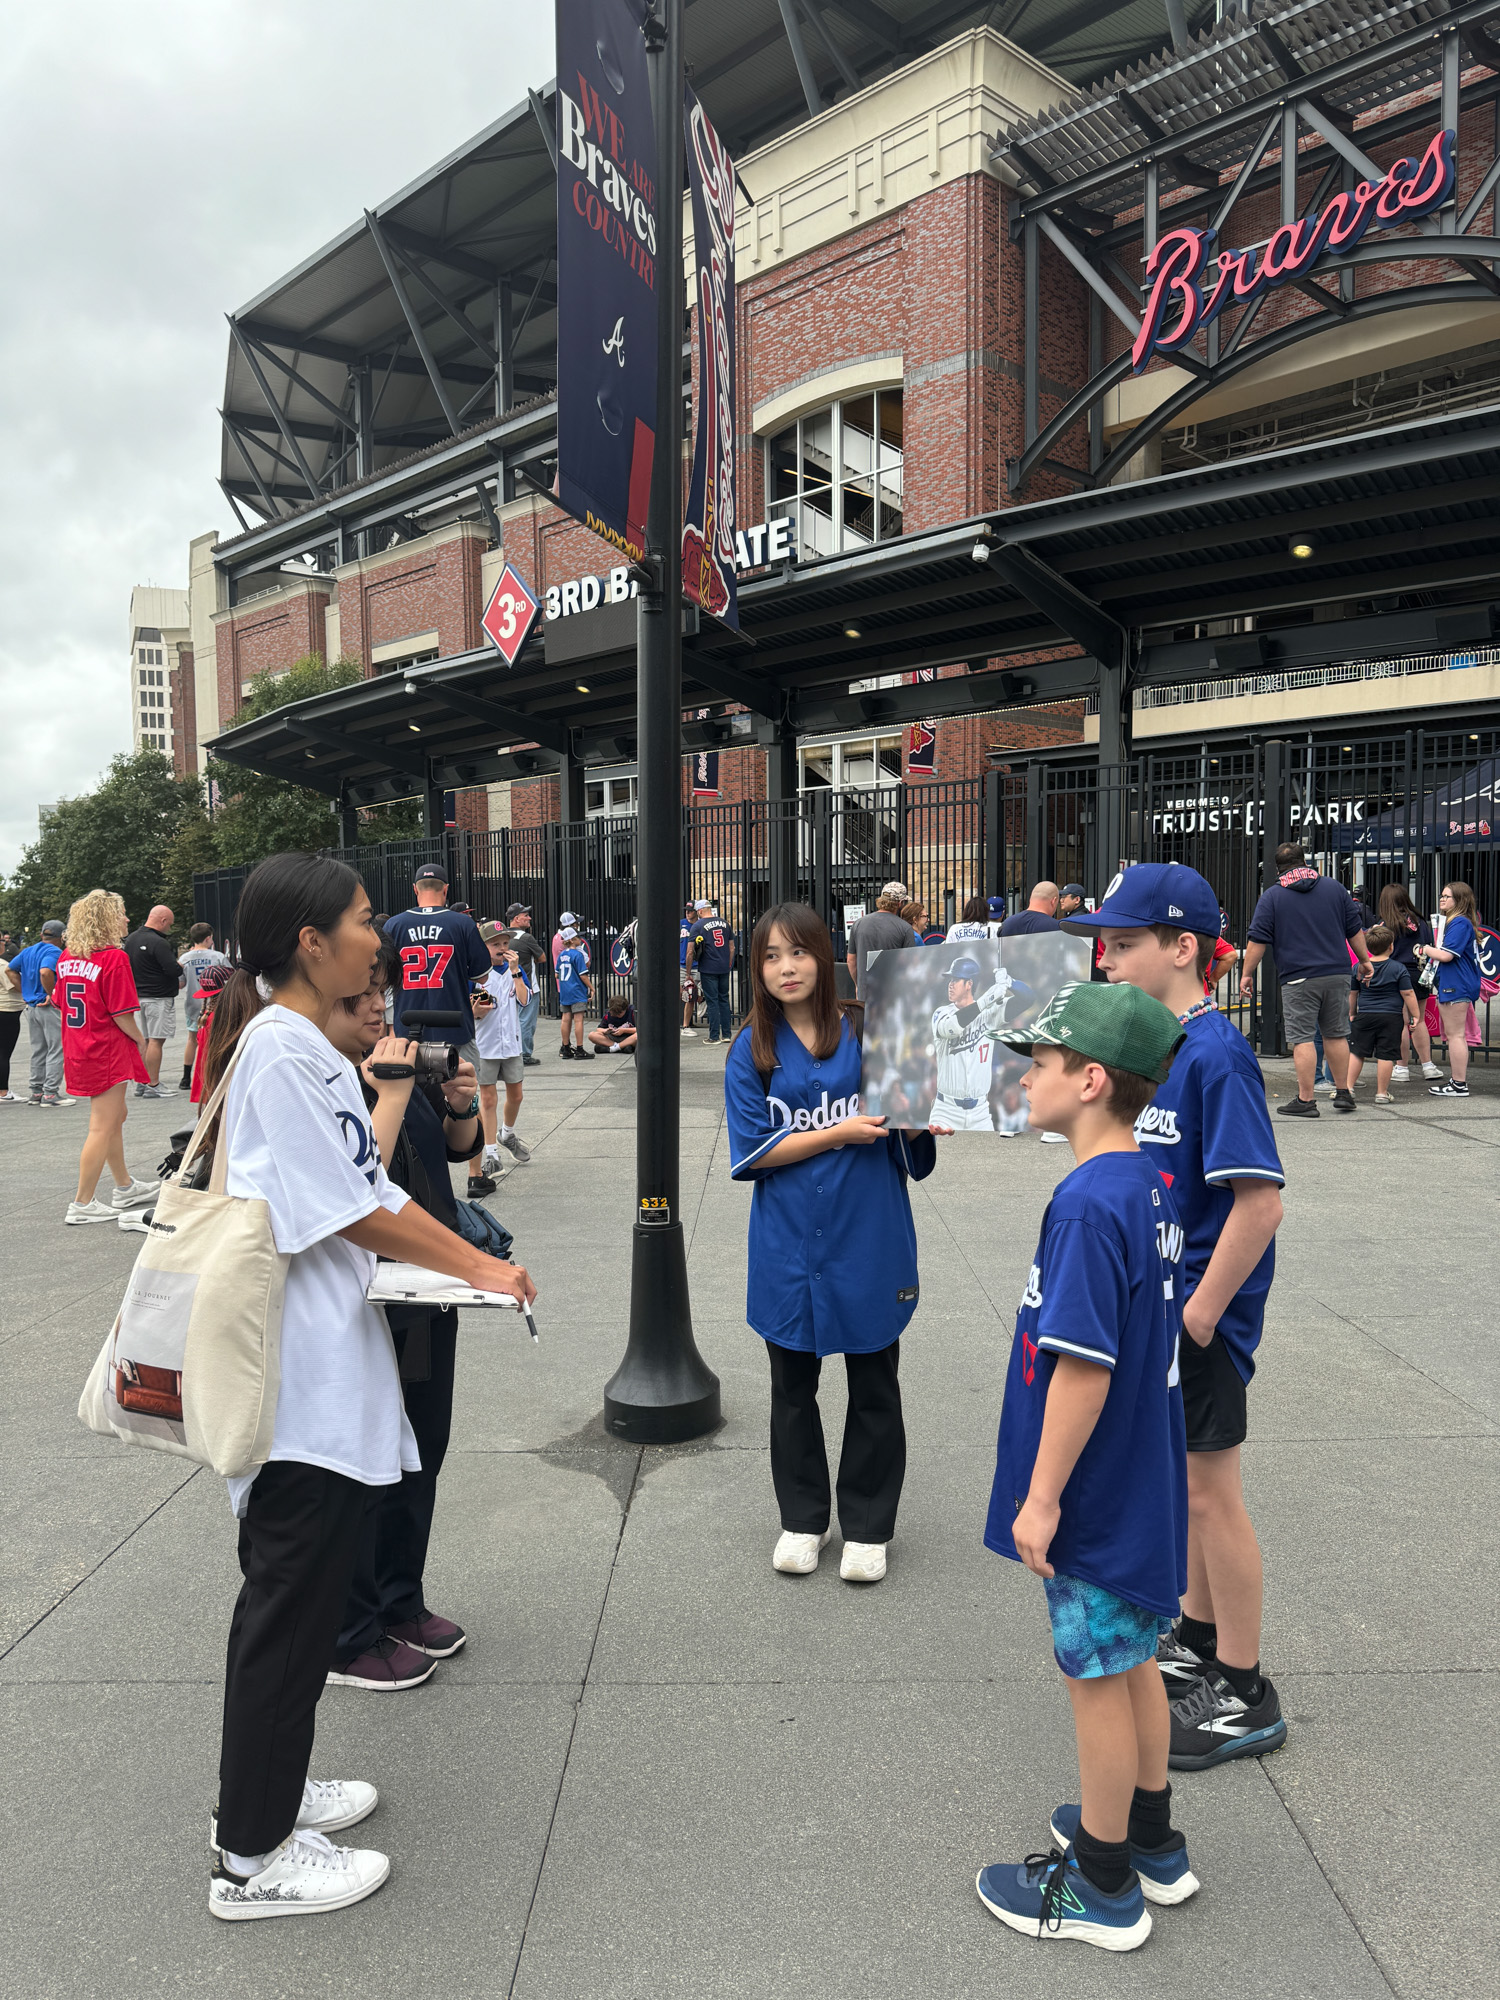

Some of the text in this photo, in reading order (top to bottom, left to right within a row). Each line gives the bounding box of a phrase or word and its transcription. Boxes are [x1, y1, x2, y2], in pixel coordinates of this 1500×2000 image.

[577, 69, 655, 210] WE ARE
[559, 88, 656, 255] Braves
[1131, 129, 1456, 374] Braves
[545, 575, 601, 620] 3RD
[1146, 801, 1365, 834] TRUIST PARK
[408, 925, 443, 942] RILEY
[703, 920, 727, 931] FREEMAN
[712, 929, 725, 947] 5
[58, 959, 102, 983] FREEMAN
[400, 945, 454, 990] 27
[559, 963, 572, 982] 17
[66, 982, 86, 1028] 5
[979, 1043, 990, 1064] 17
[641, 1197, 668, 1208] S32
